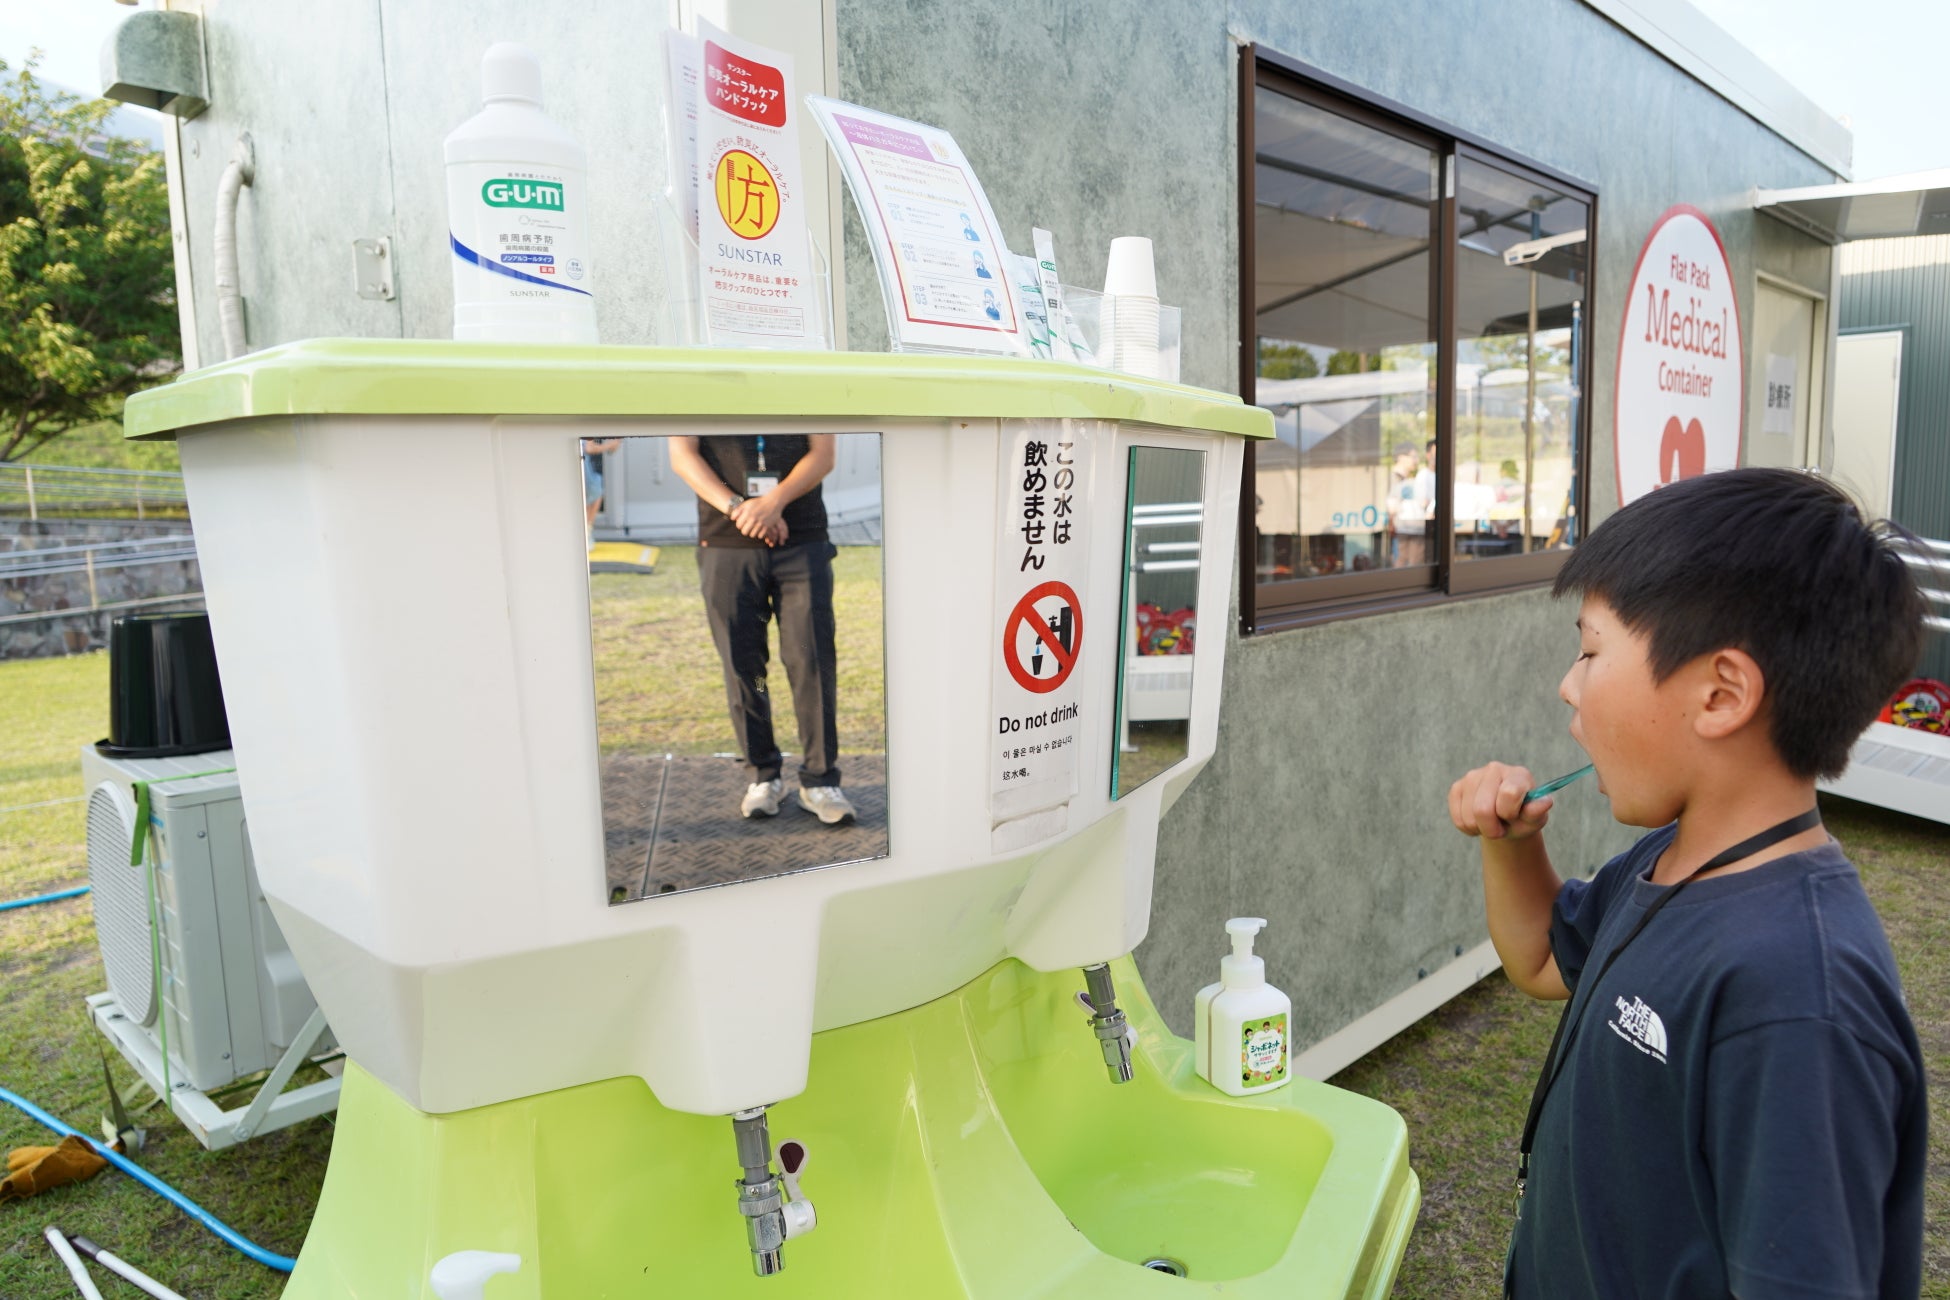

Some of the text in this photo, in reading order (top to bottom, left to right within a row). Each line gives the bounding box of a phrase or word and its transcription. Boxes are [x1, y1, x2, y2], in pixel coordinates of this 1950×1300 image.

[715, 87, 768, 114] ハンドブック
[499, 233, 554, 244] 歯周病予防
[502, 255, 552, 263] ノンアルコールタイプ
[718, 243, 783, 266] SUNSTAR
[1670, 254, 1711, 291] Flat Pack
[912, 284, 926, 292] STEP
[914, 293, 928, 305] 03
[1645, 283, 1727, 360] Medical
[1658, 360, 1713, 398] Container
[1020, 440, 1048, 572] 飲めません
[1053, 442, 1074, 544] この水は
[999, 702, 1078, 734] Do not drink
[1002, 750, 1010, 759] 이
[1044, 742, 1050, 751] 수
[1615, 995, 1650, 1033] NORTH
[1633, 995, 1652, 1020] THE
[1618, 1013, 1647, 1042] FACE
[1250, 1040, 1280, 1053] シャボネット
